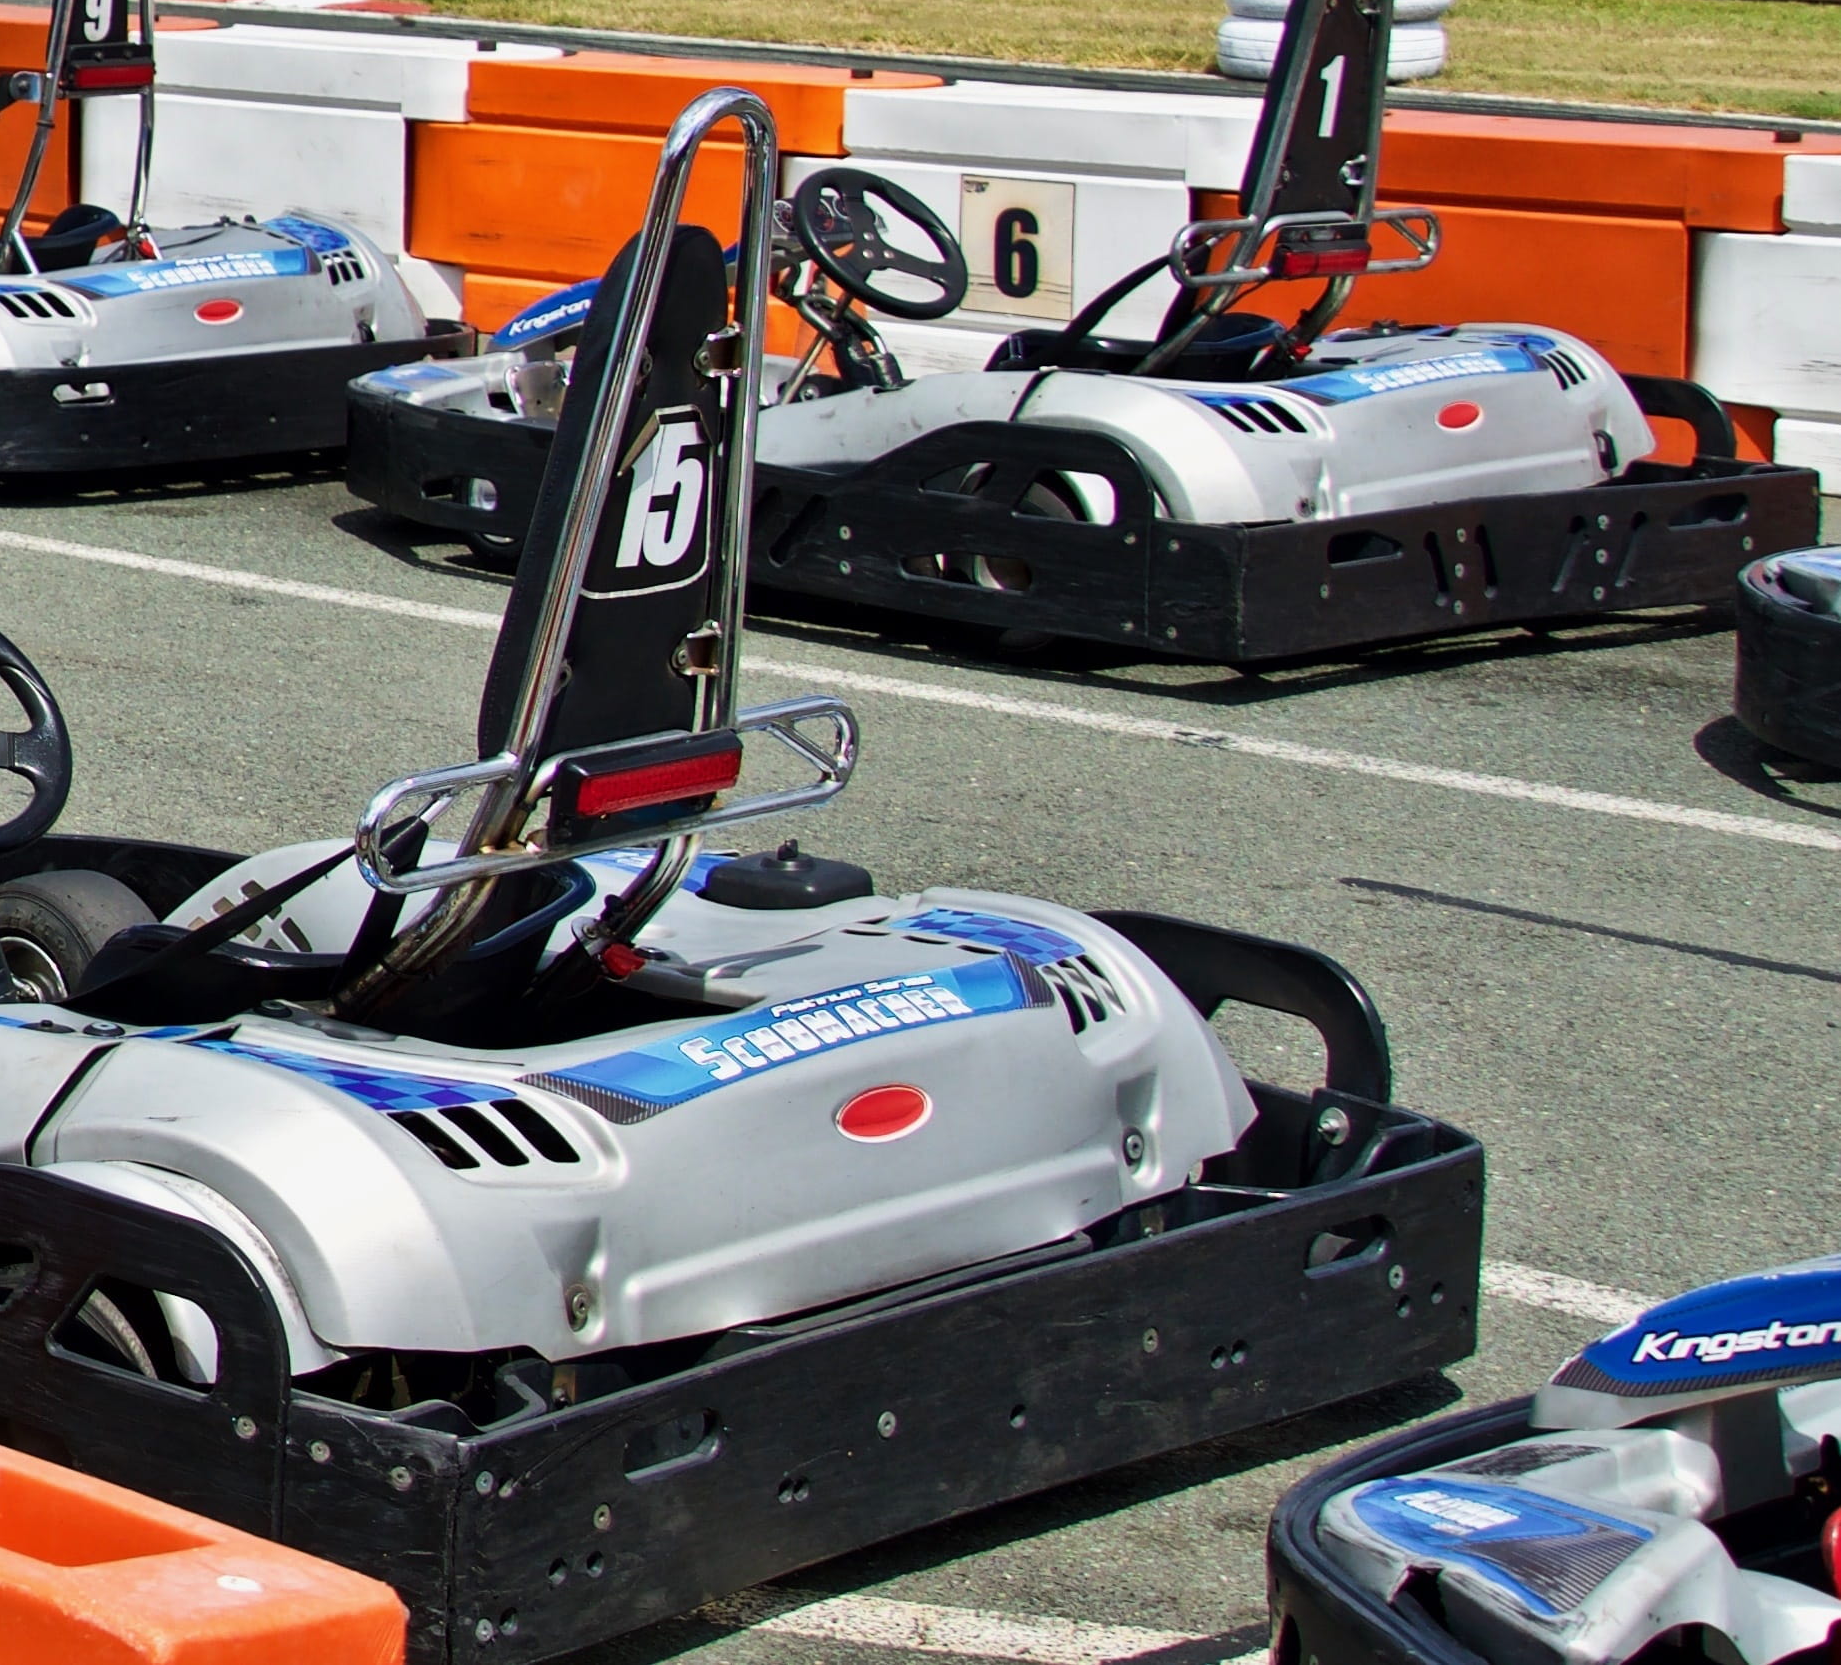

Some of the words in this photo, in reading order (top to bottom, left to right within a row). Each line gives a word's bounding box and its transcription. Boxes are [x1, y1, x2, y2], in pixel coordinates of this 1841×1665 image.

[1320, 55, 1347, 137] 1
[993, 207, 1038, 297] 6
[508, 297, 592, 337] Kingston
[614, 421, 704, 568] 15
[678, 987, 974, 1081] SCHUMACHER
[772, 987, 863, 1019] Platinum
[863, 975, 935, 994] Series
[1632, 1321, 1841, 1362] Kingston
